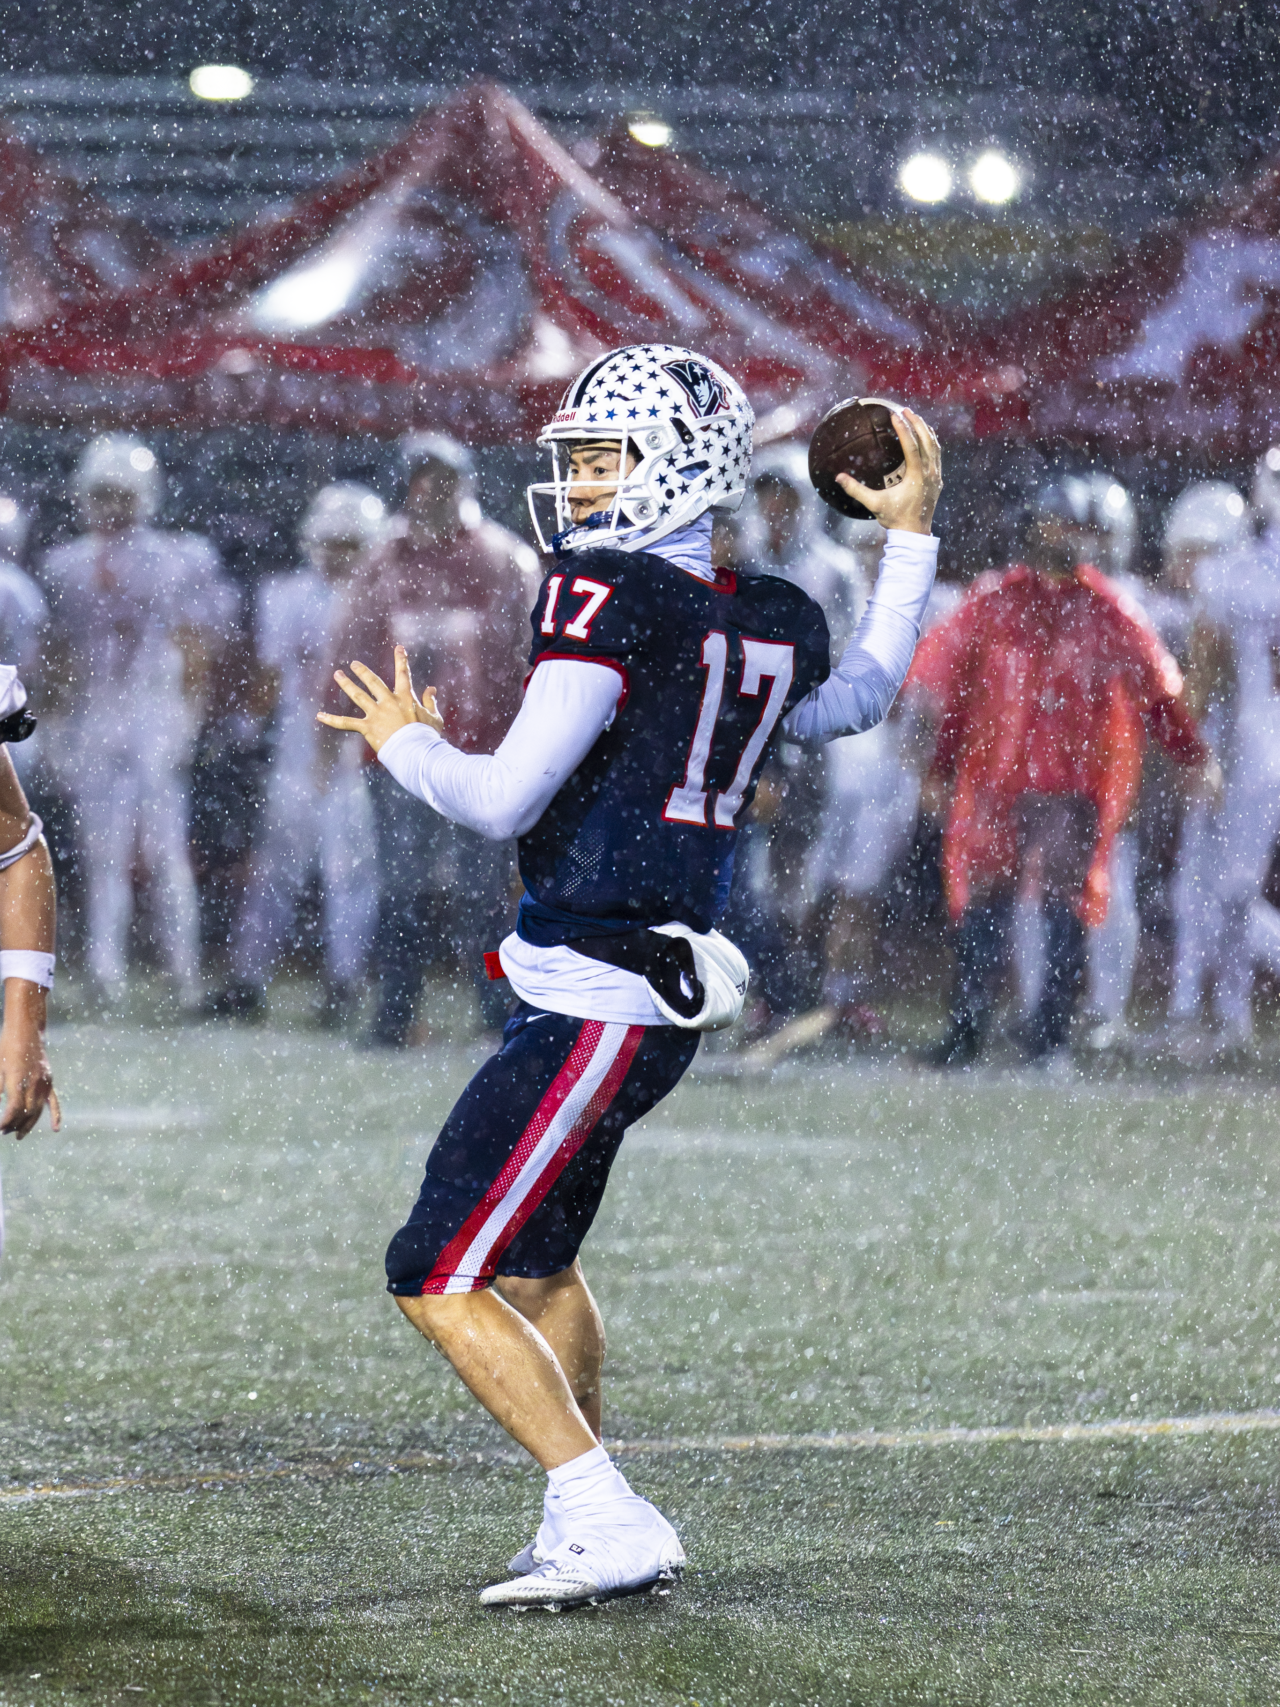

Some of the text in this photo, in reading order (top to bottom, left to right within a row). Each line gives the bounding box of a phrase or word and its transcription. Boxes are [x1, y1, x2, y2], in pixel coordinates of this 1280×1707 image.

[552, 411, 577, 423] iddell
[540, 573, 615, 643] 17
[661, 629, 796, 830] 17
